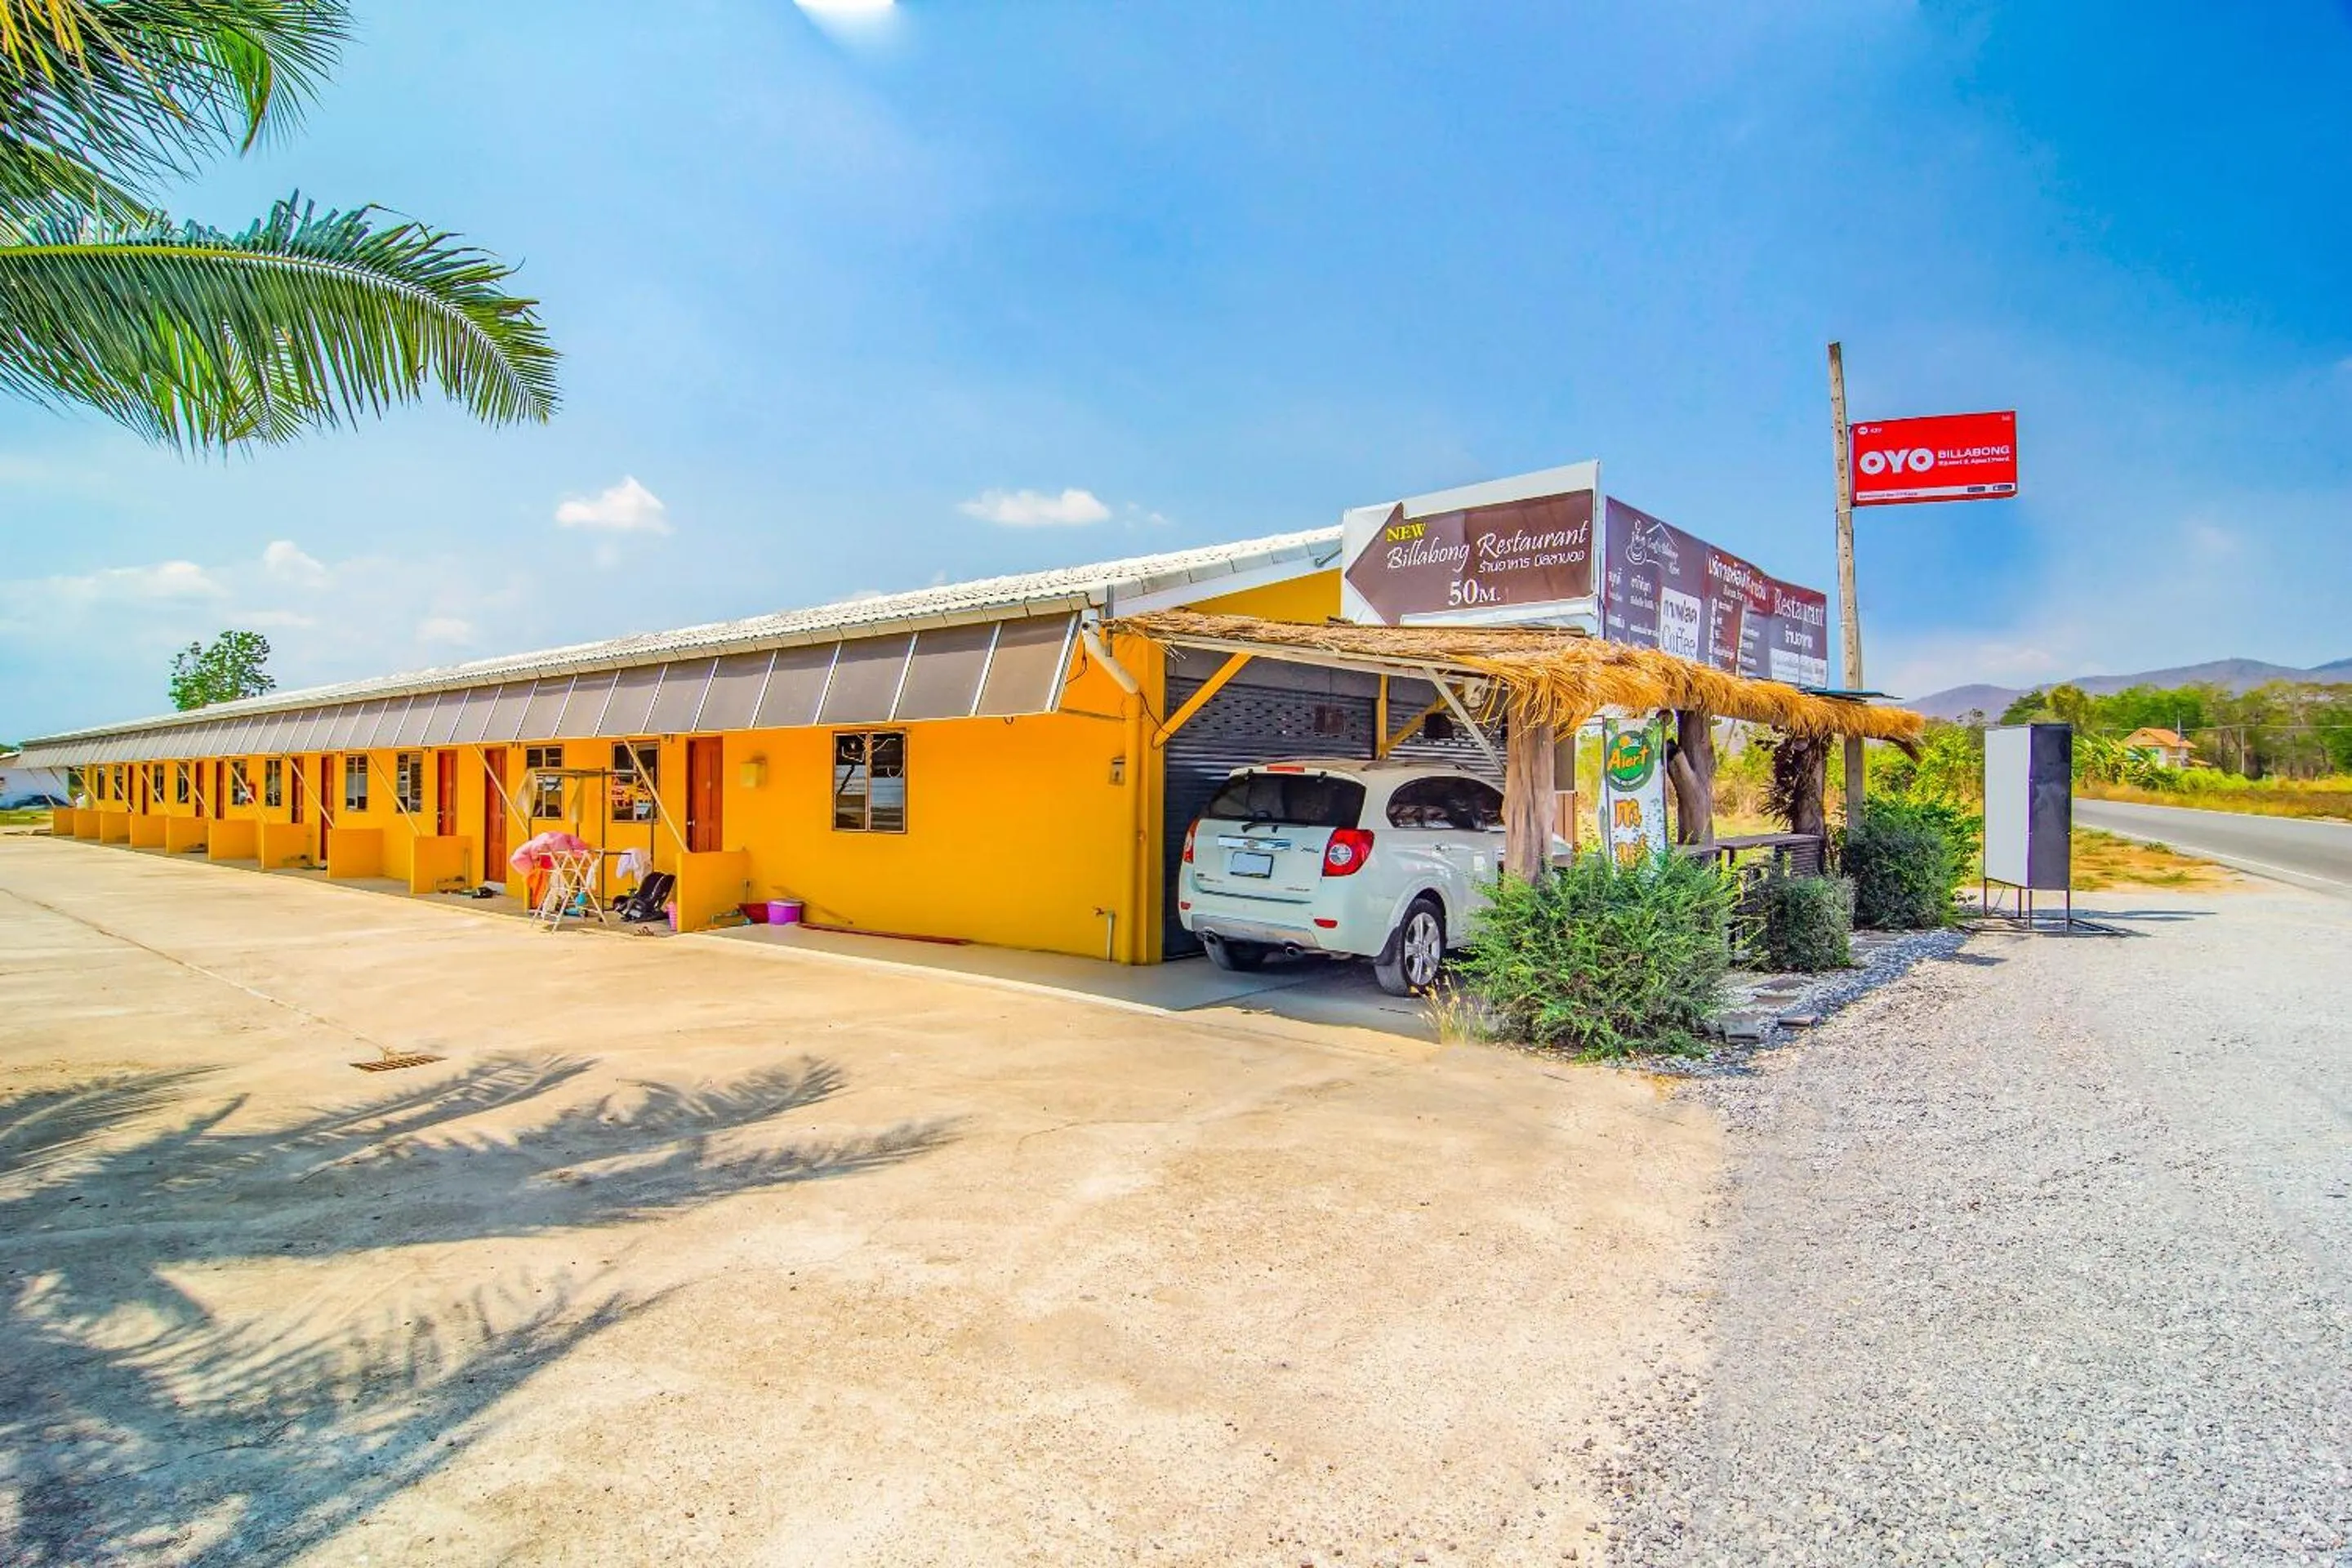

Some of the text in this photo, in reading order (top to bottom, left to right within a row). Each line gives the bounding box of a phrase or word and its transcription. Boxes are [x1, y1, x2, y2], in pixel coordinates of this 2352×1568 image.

[1860, 448, 1935, 475] OYO
[1938, 445, 2010, 459] BILLABONG
[1386, 523, 1428, 542] NEW
[1388, 537, 1470, 572] Billabong
[1477, 519, 1589, 559] Restaurant
